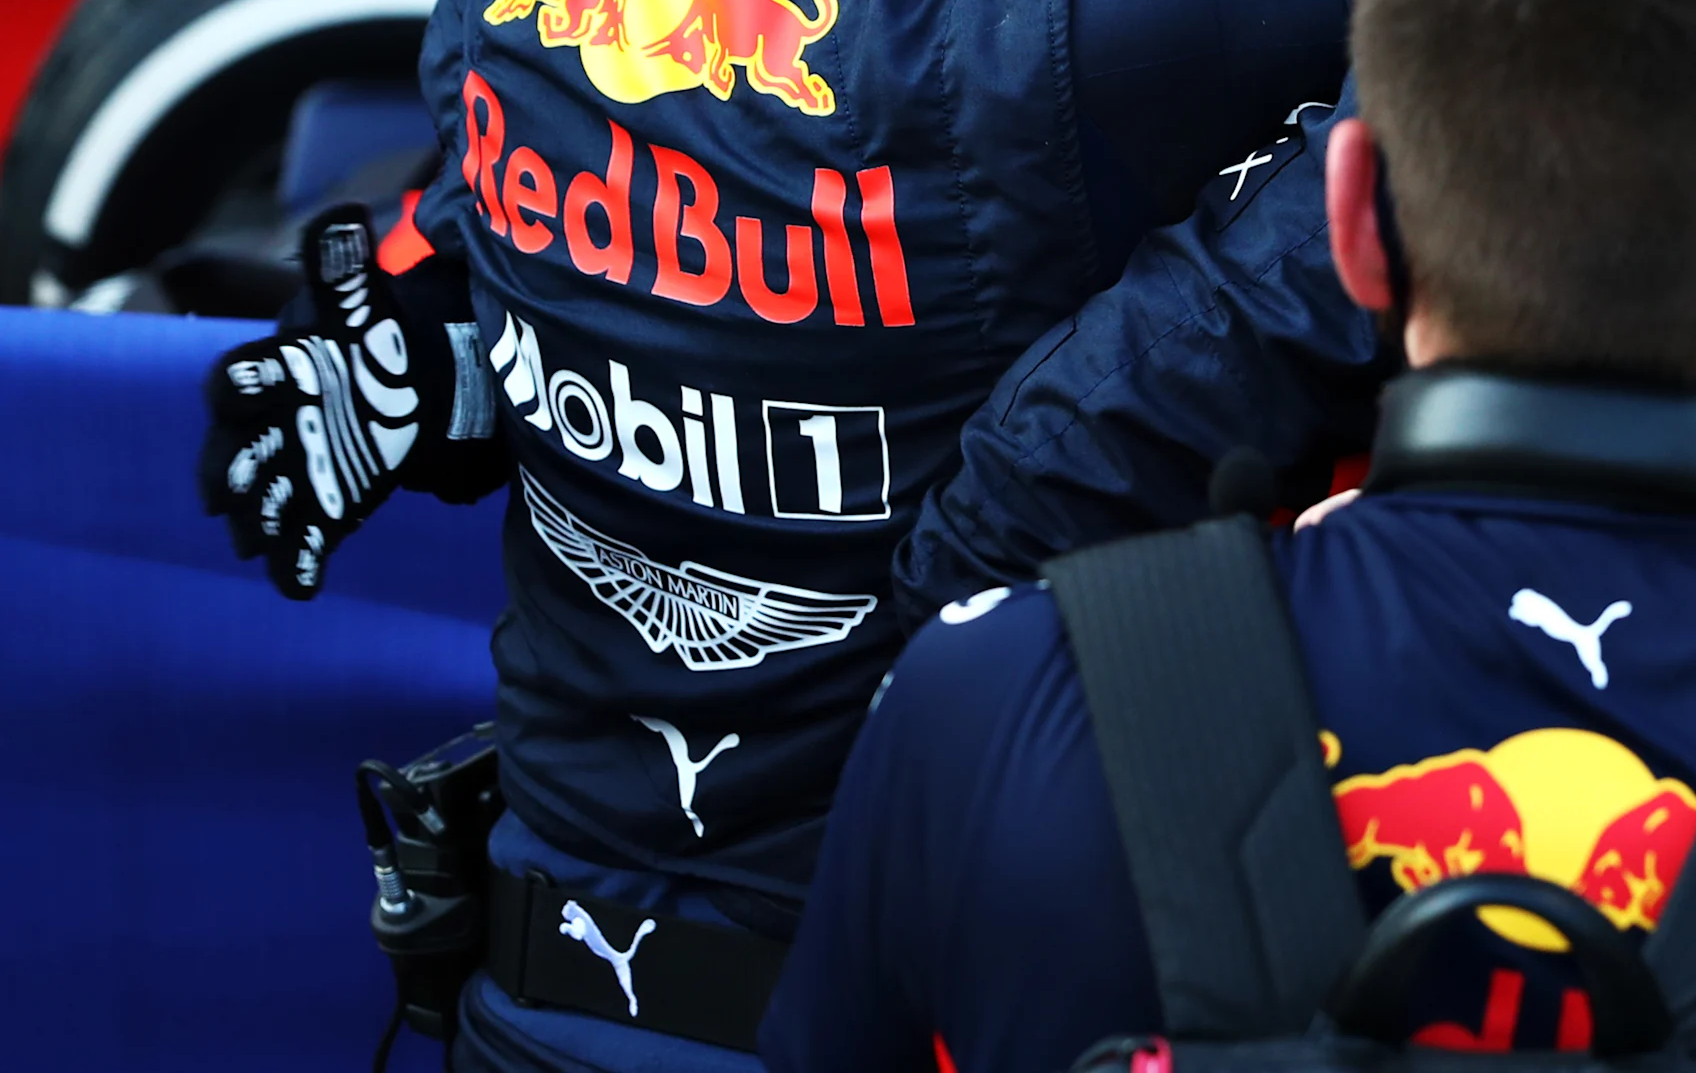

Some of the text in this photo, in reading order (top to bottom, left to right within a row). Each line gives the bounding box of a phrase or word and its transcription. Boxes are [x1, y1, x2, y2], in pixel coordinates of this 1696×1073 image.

[462, 69, 916, 328] Red Bull
[489, 310, 746, 515] Mobil
[599, 548, 739, 619] ASTON MARTIN
